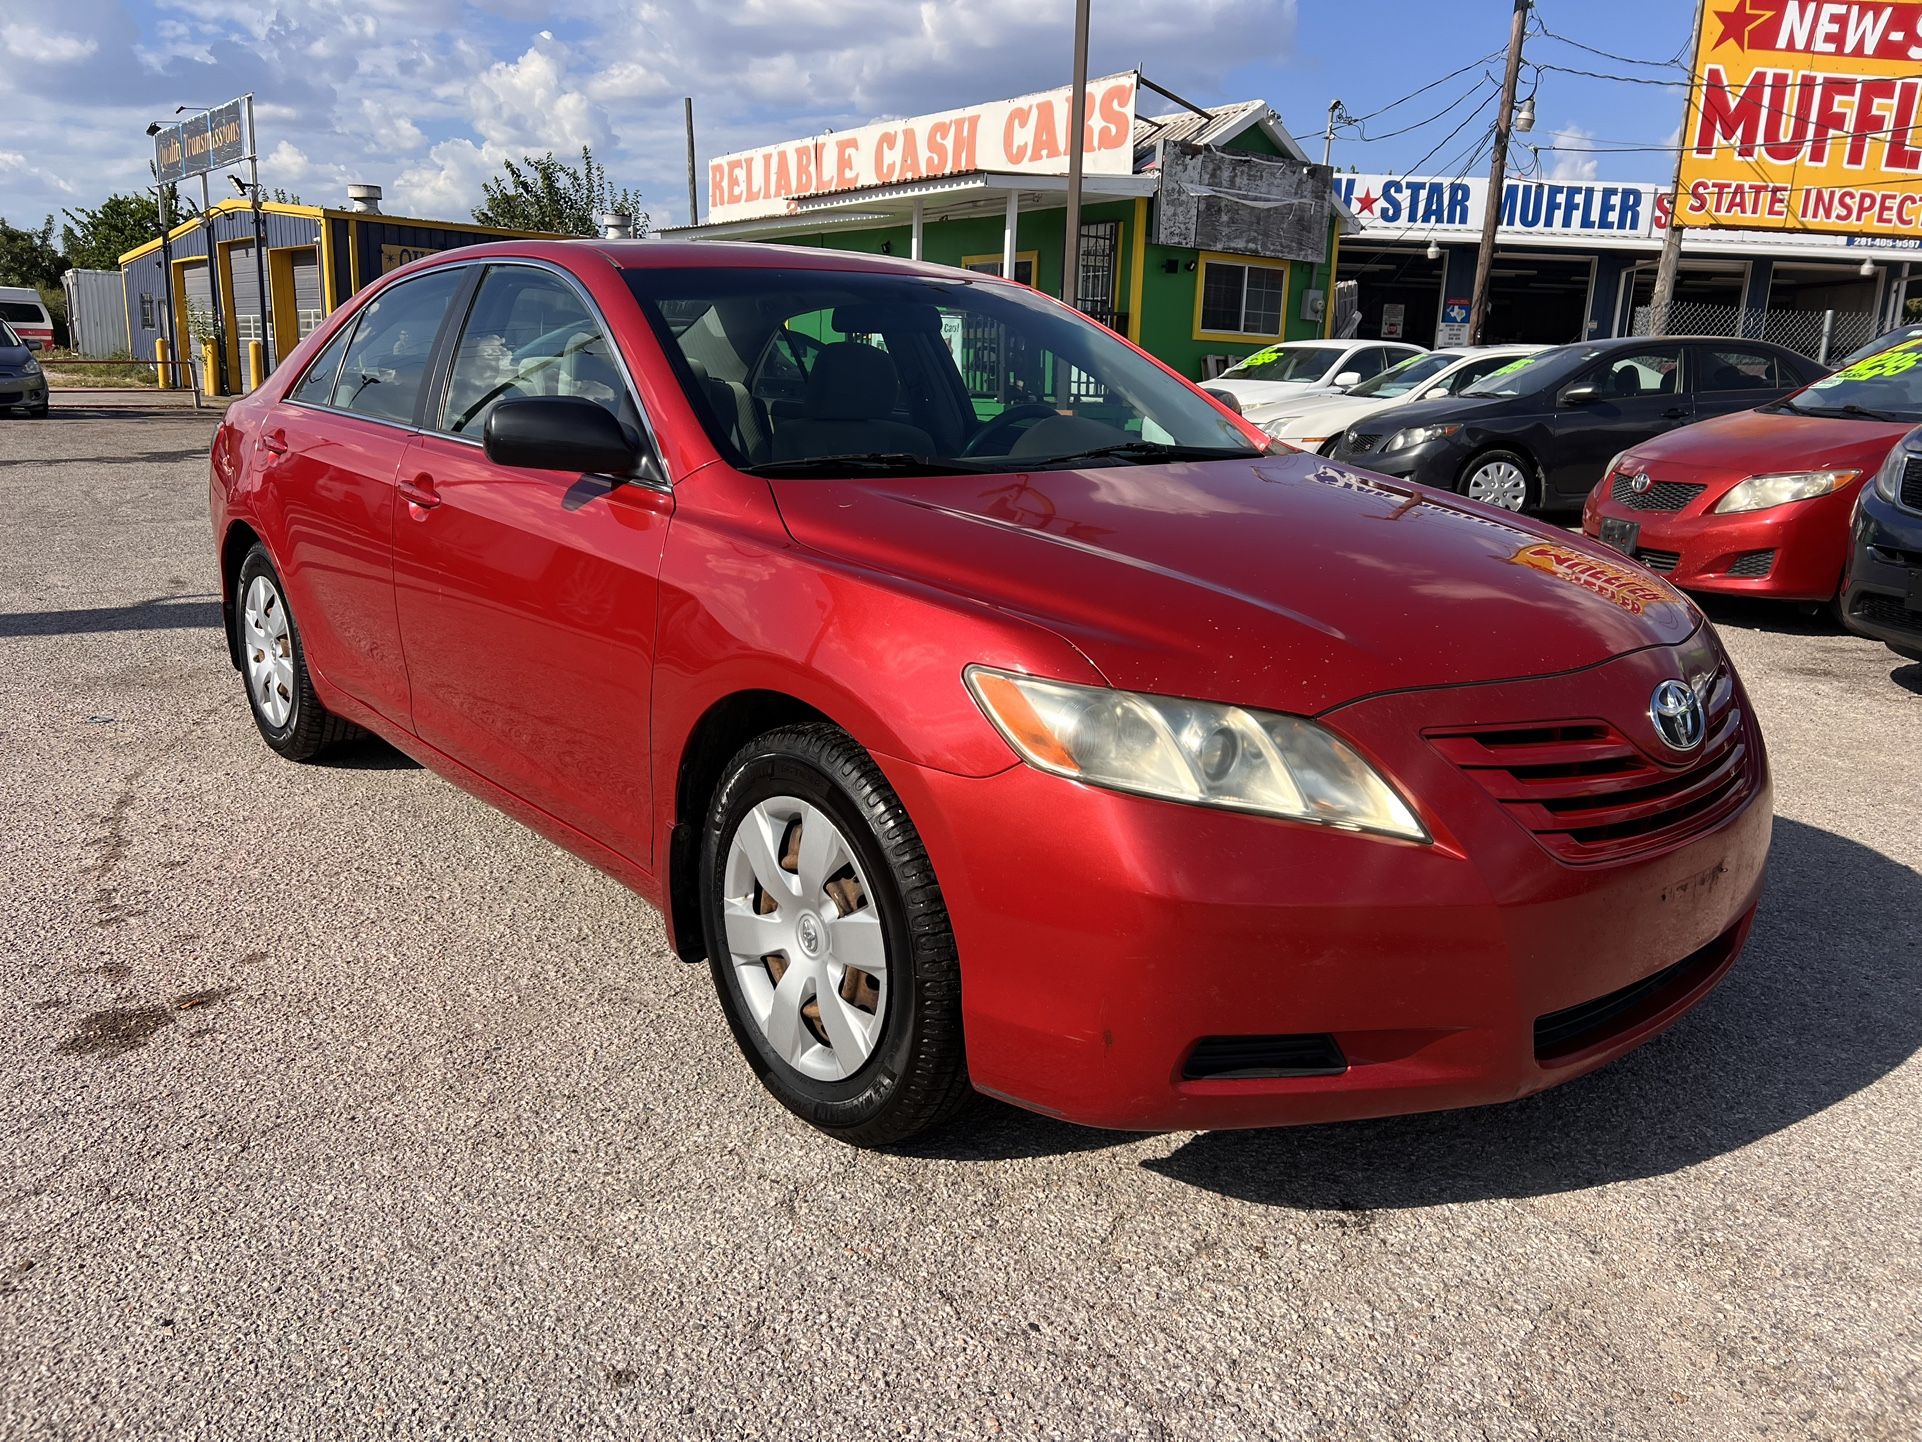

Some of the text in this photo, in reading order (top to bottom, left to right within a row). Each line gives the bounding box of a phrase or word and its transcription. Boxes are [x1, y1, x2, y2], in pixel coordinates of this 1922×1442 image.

[160, 120, 241, 168] Quality Transmissions
[711, 83, 1134, 207] RELIABLE CASH CARS
[1693, 65, 1922, 174] MUFFL
[1380, 179, 1471, 224] STAR
[1498, 184, 1643, 230] MUFFLER
[1688, 180, 1791, 218] STATE
